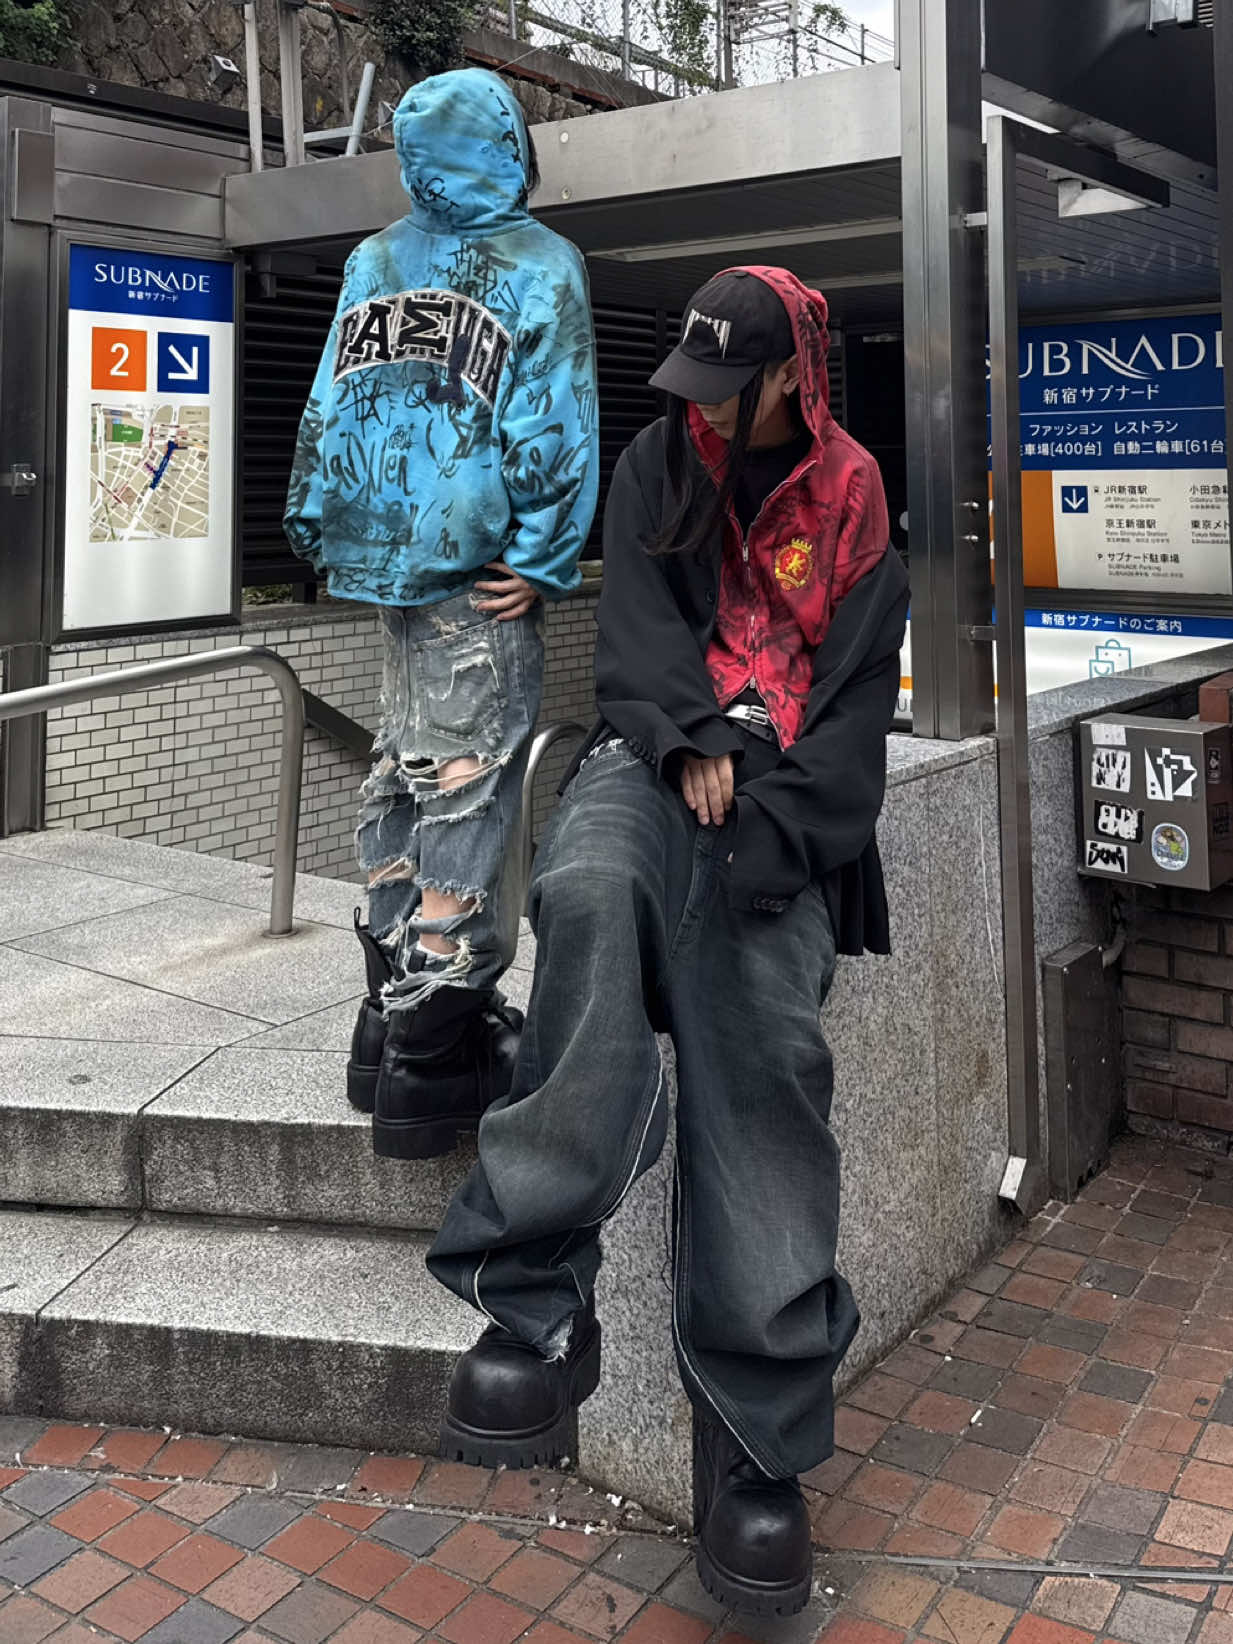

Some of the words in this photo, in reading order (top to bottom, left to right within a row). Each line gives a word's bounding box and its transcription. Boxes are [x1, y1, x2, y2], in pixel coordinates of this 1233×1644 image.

[94, 263, 211, 293] SUBNADE
[109, 342, 129, 377] 2
[1042, 384, 1160, 405] 新宿サブナード
[1028, 422, 1104, 437] ファッション
[1113, 420, 1179, 435] レストラン
[1103, 485, 1148, 496] JR新宿駅
[1105, 519, 1157, 530] 京王新宿駅
[1041, 613, 1183, 633] 新宿サブナードのご案内
